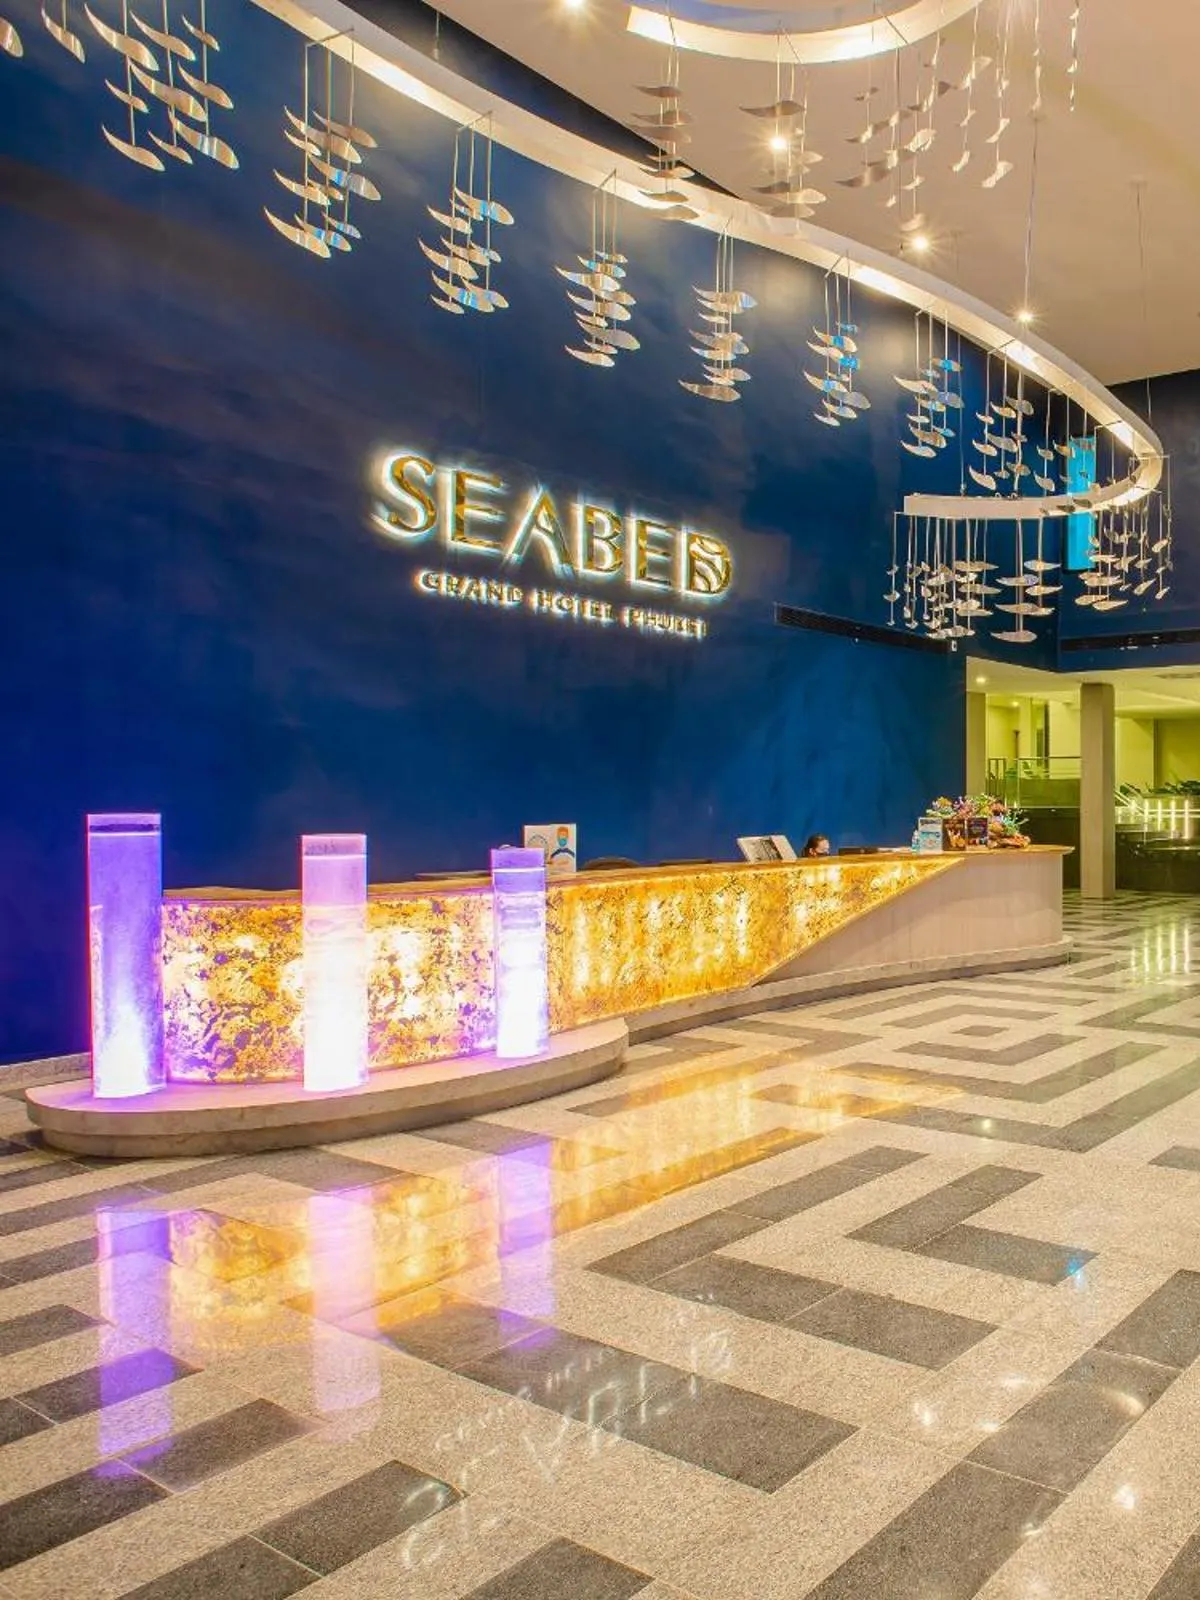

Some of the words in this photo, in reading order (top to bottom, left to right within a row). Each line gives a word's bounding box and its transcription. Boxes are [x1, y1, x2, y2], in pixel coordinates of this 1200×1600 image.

[370, 450, 733, 600] SEABED
[418, 570, 523, 606] GRAND
[531, 589, 616, 624] HOTEL
